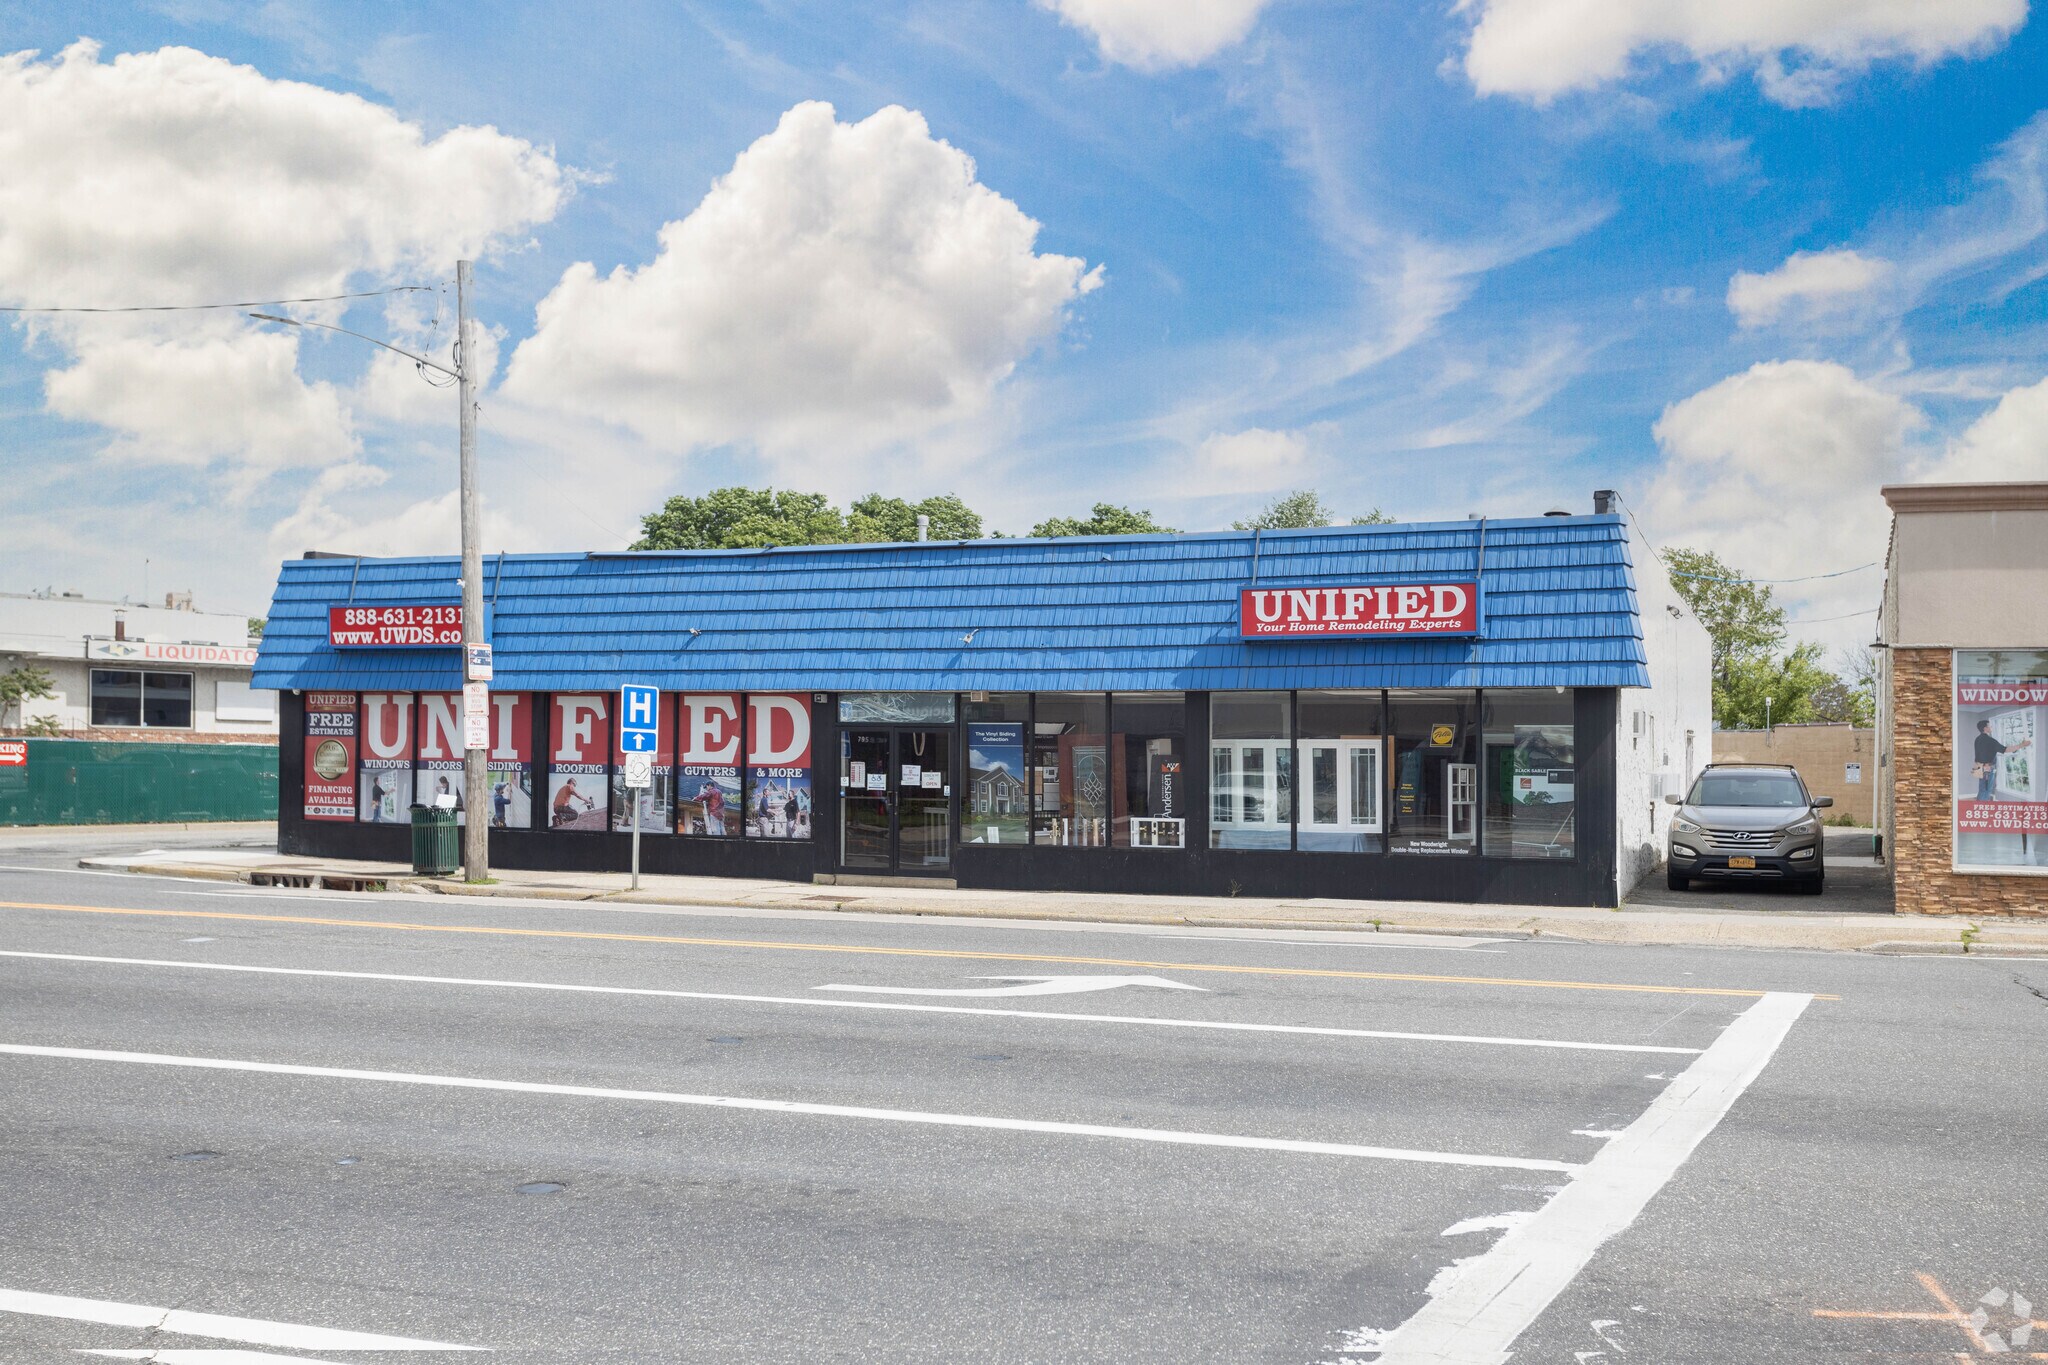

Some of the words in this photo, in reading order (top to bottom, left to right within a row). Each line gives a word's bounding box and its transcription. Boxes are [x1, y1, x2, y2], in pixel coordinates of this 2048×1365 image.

[1251, 585, 1467, 622] UNIFIED
[345, 608, 463, 626] 888-631-2131
[1256, 622, 1286, 632] Your
[1288, 621, 1325, 632] Home
[1328, 620, 1405, 632] Remodeling
[1409, 619, 1462, 631] Experts
[309, 694, 357, 705] UNIFIED
[629, 691, 651, 724] H
[309, 712, 354, 727] FREE
[309, 728, 354, 736] ESTIMATES
[364, 759, 411, 769] WINDOWS
[428, 760, 463, 770] DOORS
[487, 761, 523, 772] SIDING
[555, 763, 604, 774] ROOFING
[617, 765, 671, 776] MNRY
[684, 766, 736, 777] GUTTERS
[756, 767, 766, 778] &
[767, 768, 803, 778] MORE
[308, 785, 353, 794] FINANCING
[308, 796, 353, 805] AVAILABLE
[1161, 773, 1172, 819] Andersen
[1390, 846, 1420, 854] Double-Hung
[1420, 847, 1450, 855] Replacement
